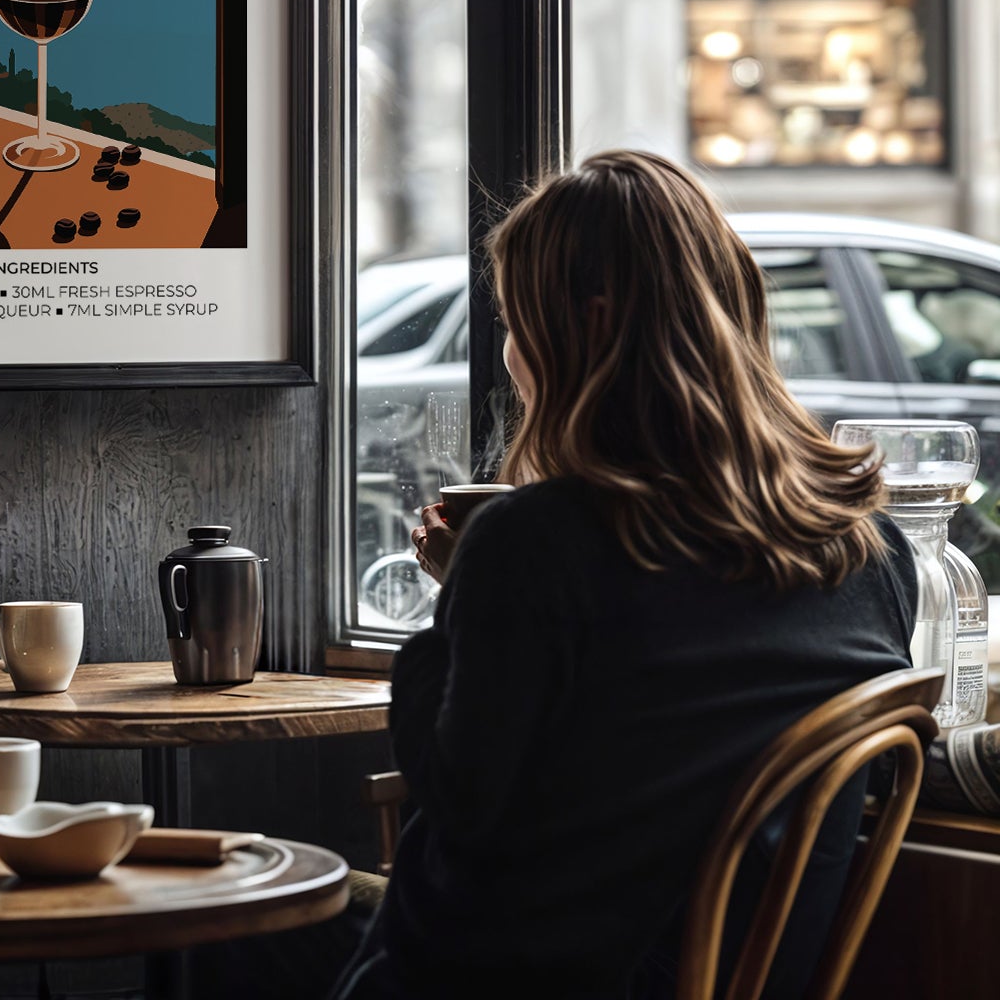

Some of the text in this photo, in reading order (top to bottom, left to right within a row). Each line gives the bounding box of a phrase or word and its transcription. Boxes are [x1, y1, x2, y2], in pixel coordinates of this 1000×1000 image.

[11, 285, 55, 299] 30ML
[59, 285, 110, 299] FRESH
[115, 284, 198, 298] ESPRESSO
[67, 303, 102, 317] 7ML
[104, 303, 162, 317] SIMPLE
[166, 302, 219, 316] SYRUP
